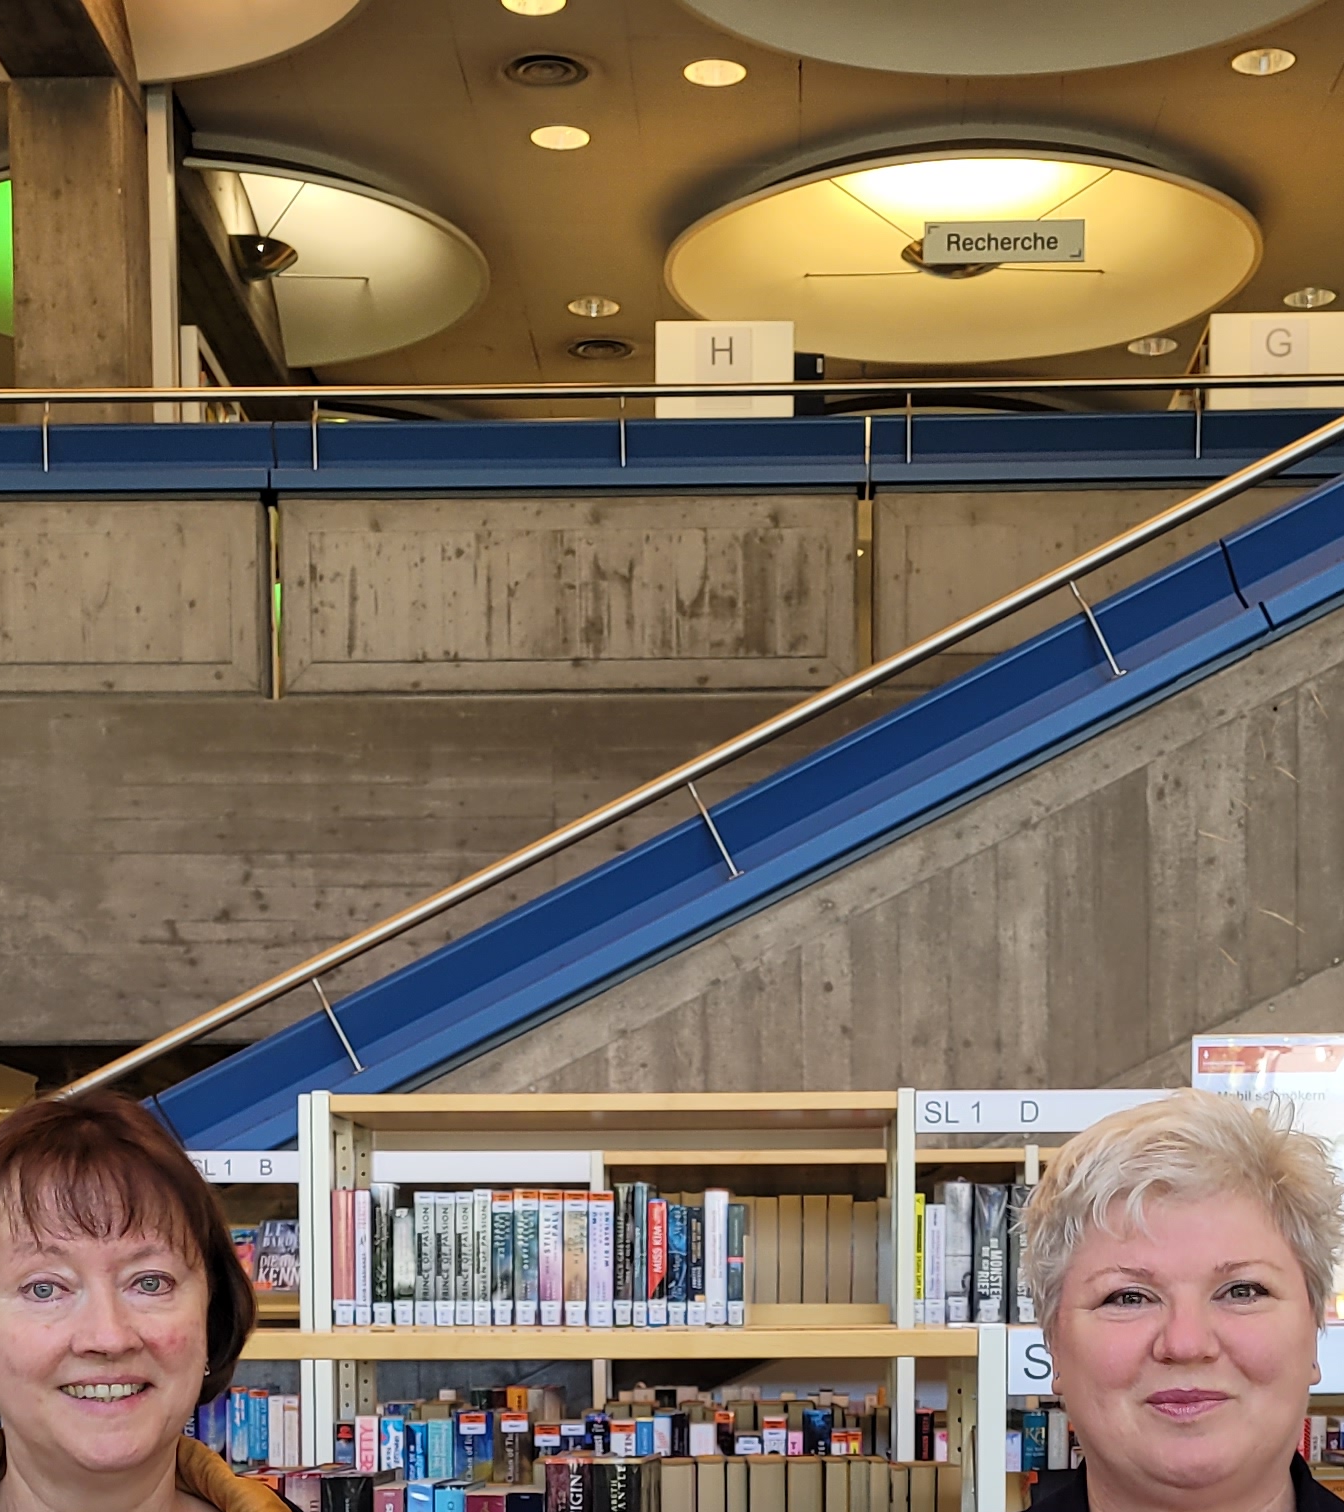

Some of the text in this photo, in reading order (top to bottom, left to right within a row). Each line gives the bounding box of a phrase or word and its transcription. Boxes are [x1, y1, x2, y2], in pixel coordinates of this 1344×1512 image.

[945, 226, 1059, 258] Recherche
[709, 335, 735, 366] H
[1263, 326, 1294, 359] G
[924, 1101, 1039, 1124] SL 1 D
[225, 1159, 232, 1176] 1
[260, 1159, 273, 1176] B
[653, 1224, 662, 1273] MISS KIM
